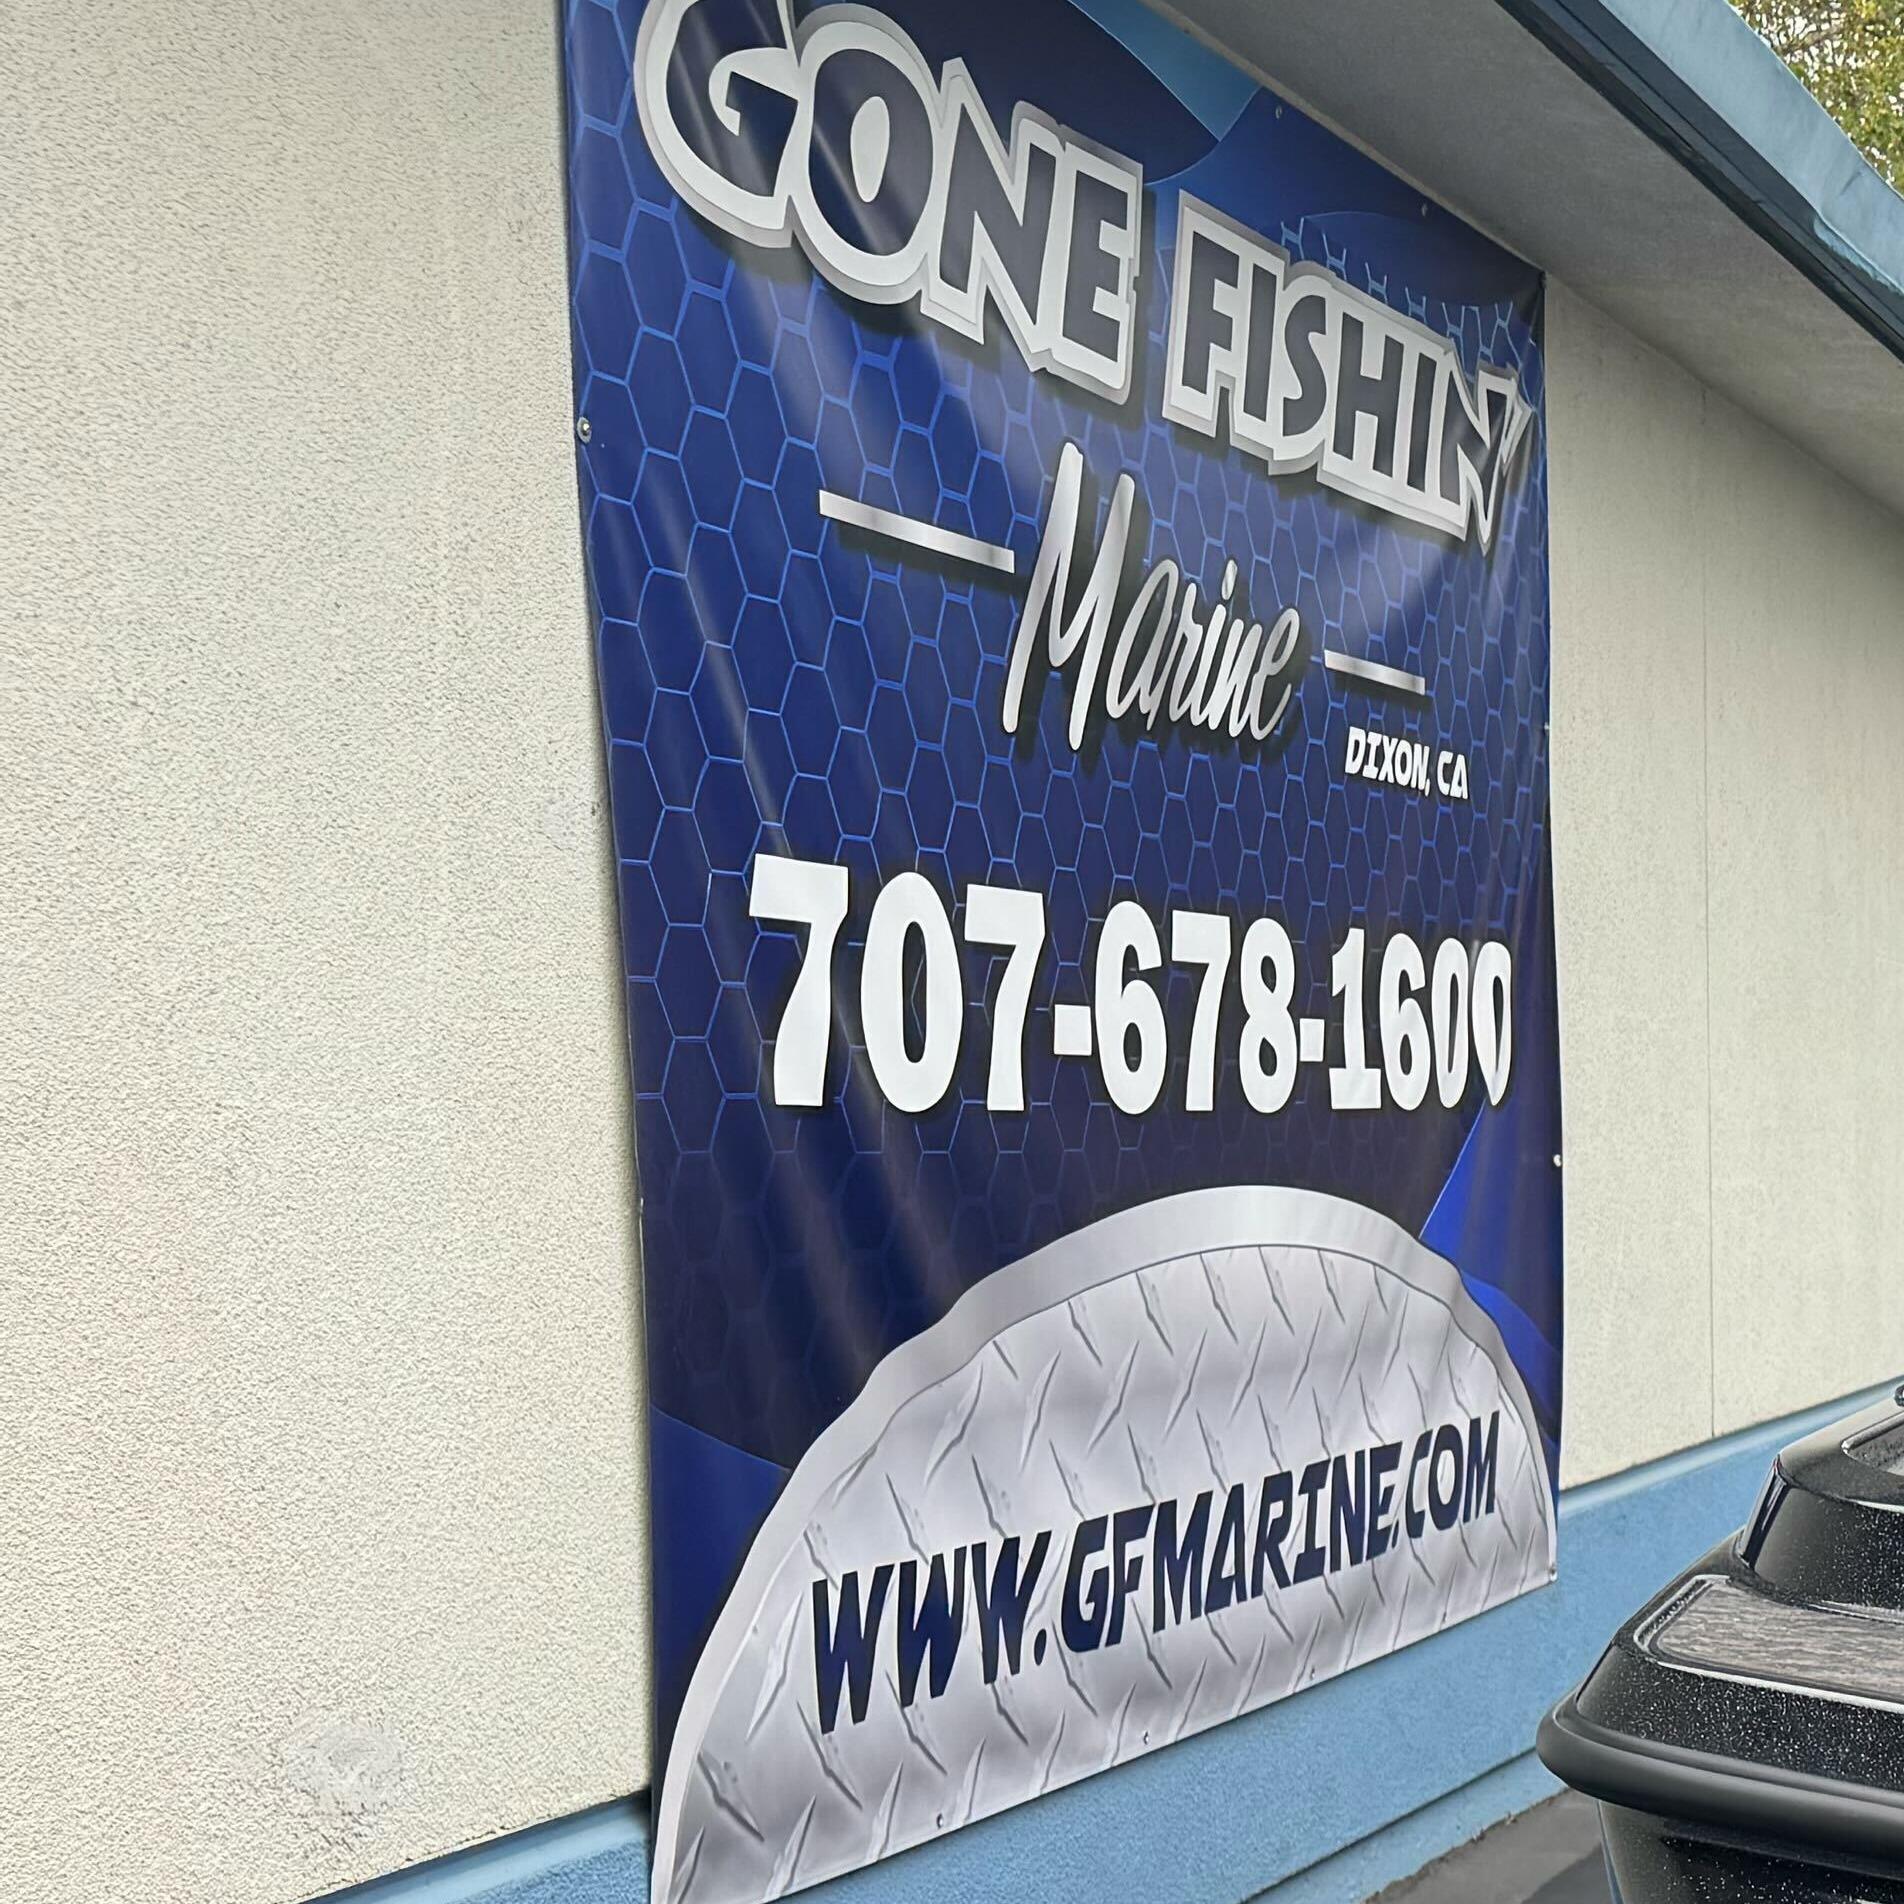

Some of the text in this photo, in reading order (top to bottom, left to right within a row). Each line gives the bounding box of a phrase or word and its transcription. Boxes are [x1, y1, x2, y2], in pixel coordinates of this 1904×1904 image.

[640, 0, 1141, 396] GONE
[1002, 442, 1300, 751] Marine
[1344, 725, 1469, 800] DIXON, CA
[747, 852, 1512, 1115] 707-678-1600
[811, 1411, 1500, 1735] WWW.GFMARINE.COM
